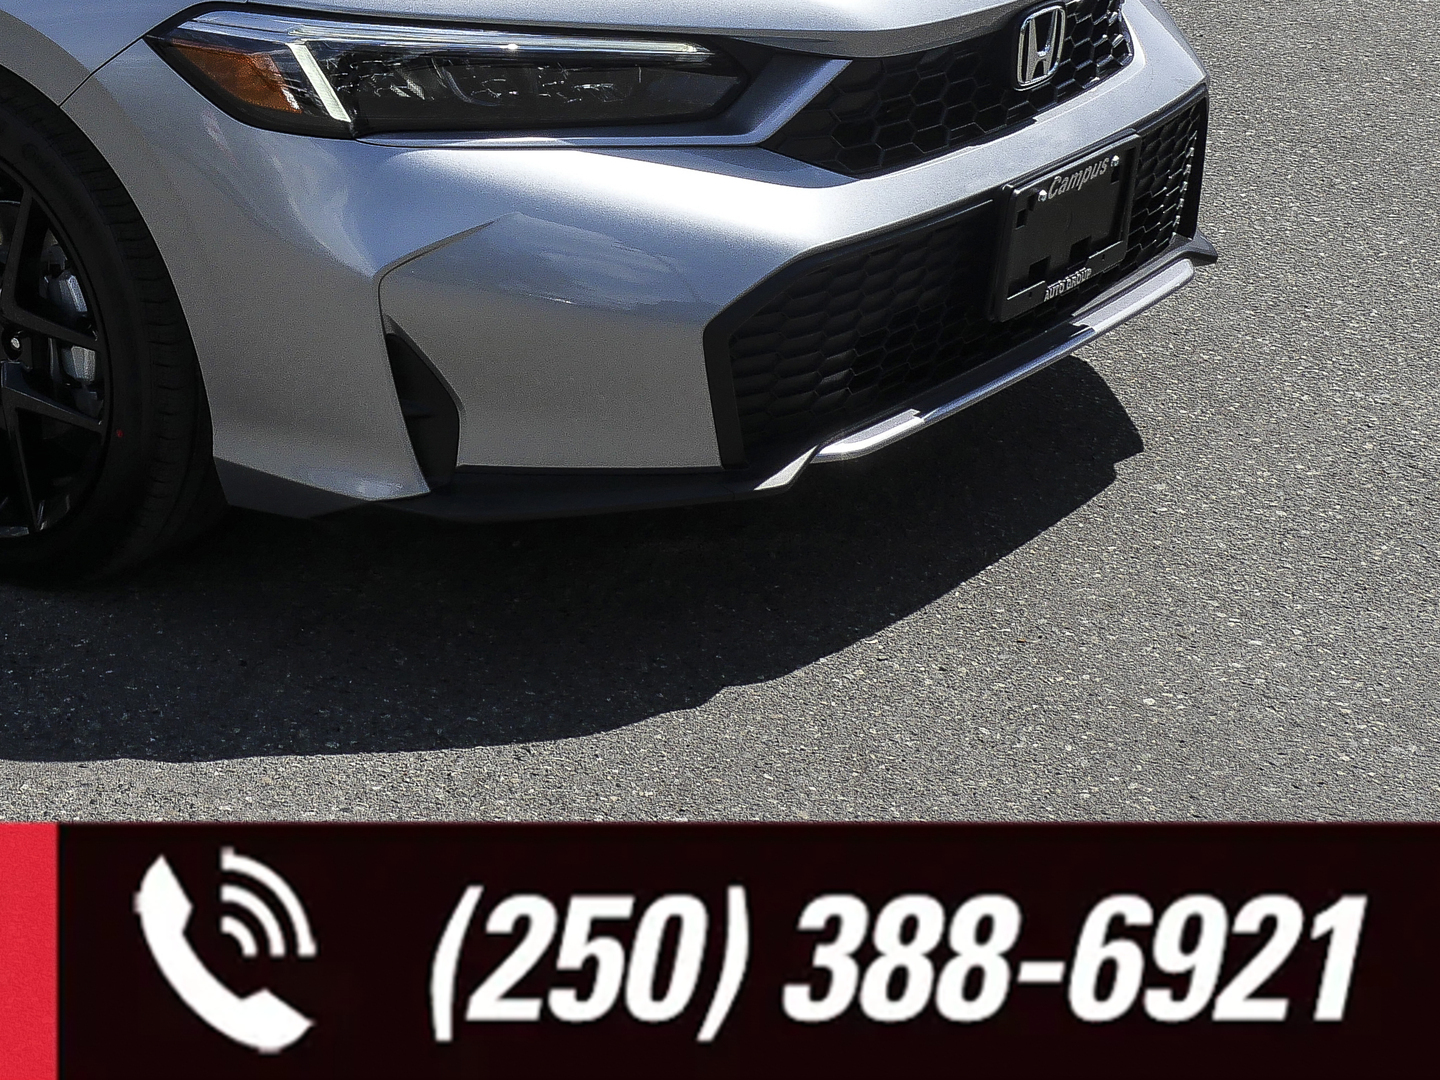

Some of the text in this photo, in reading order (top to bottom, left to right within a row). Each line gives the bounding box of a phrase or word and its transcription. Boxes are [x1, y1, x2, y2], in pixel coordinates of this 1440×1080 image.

[1047, 157, 1110, 200] Campus
[1044, 266, 1092, 302] AUTO GROUP
